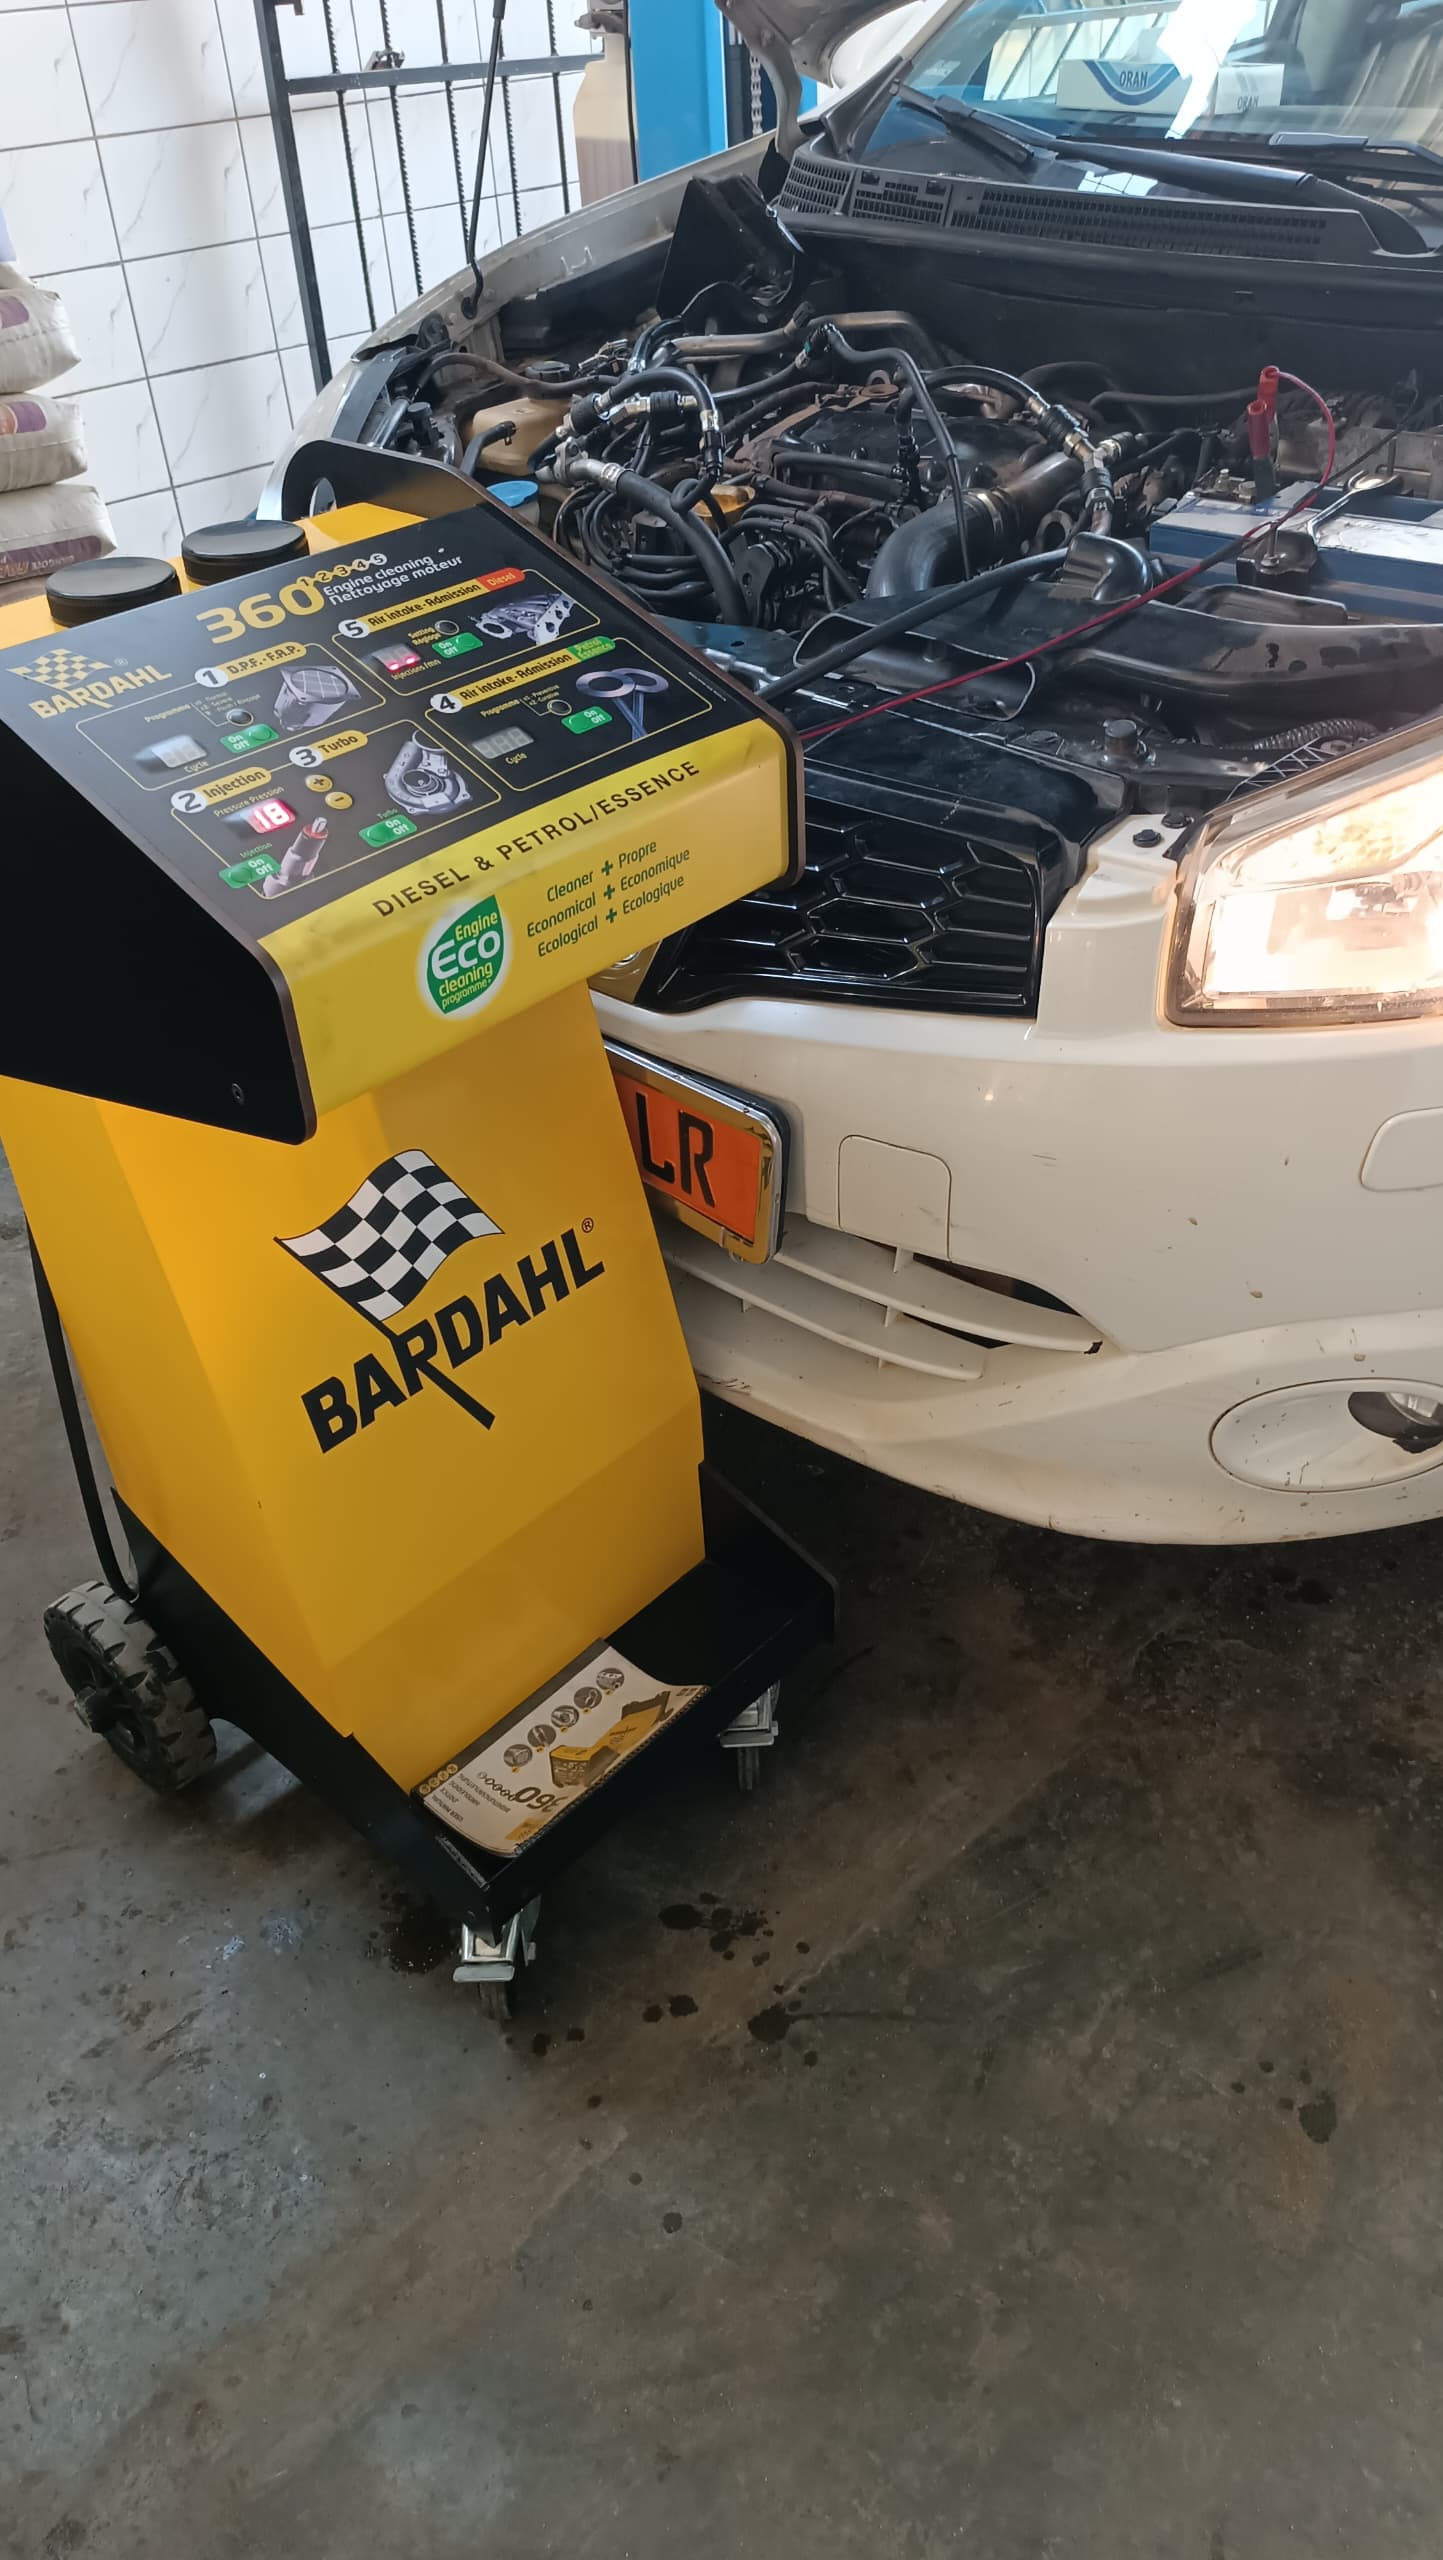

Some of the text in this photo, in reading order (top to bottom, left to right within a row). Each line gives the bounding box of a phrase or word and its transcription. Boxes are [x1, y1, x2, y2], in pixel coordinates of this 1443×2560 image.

[1119, 70, 1148, 89] ORAN
[1236, 96, 1260, 113] ORAN
[323, 555, 434, 596] Engine cleaning
[329, 556, 463, 606] Nettoyage moteur
[196, 581, 325, 644] 360
[344, 620, 364, 638] 5
[367, 615, 387, 627] Air
[28, 664, 173, 719] BARDAHL
[201, 670, 218, 685] 1
[439, 695, 456, 710] 4
[459, 689, 479, 701] Air
[227, 734, 243, 744] On
[233, 740, 250, 751] Off
[296, 734, 359, 766] 3 Turbo
[178, 769, 266, 812] 2 Injection
[253, 800, 290, 830] 18
[385, 819, 402, 828] On
[372, 760, 701, 917] DIESEL & PETROL/ESSENCE
[248, 857, 265, 869] On
[255, 863, 273, 876] Off
[546, 869, 594, 903] Cleaner
[618, 841, 657, 869] Propre
[527, 892, 596, 938] Economical
[620, 849, 690, 892] Economique
[454, 911, 498, 942] Engine
[537, 916, 599, 958] Ecological
[622, 875, 685, 916] Ecologique
[431, 930, 501, 980] Eco
[438, 961, 494, 998] cleaning
[441, 978, 487, 1010] programme
[635, 1090, 716, 1209] LR
[301, 1227, 605, 1454] BARDAHL
